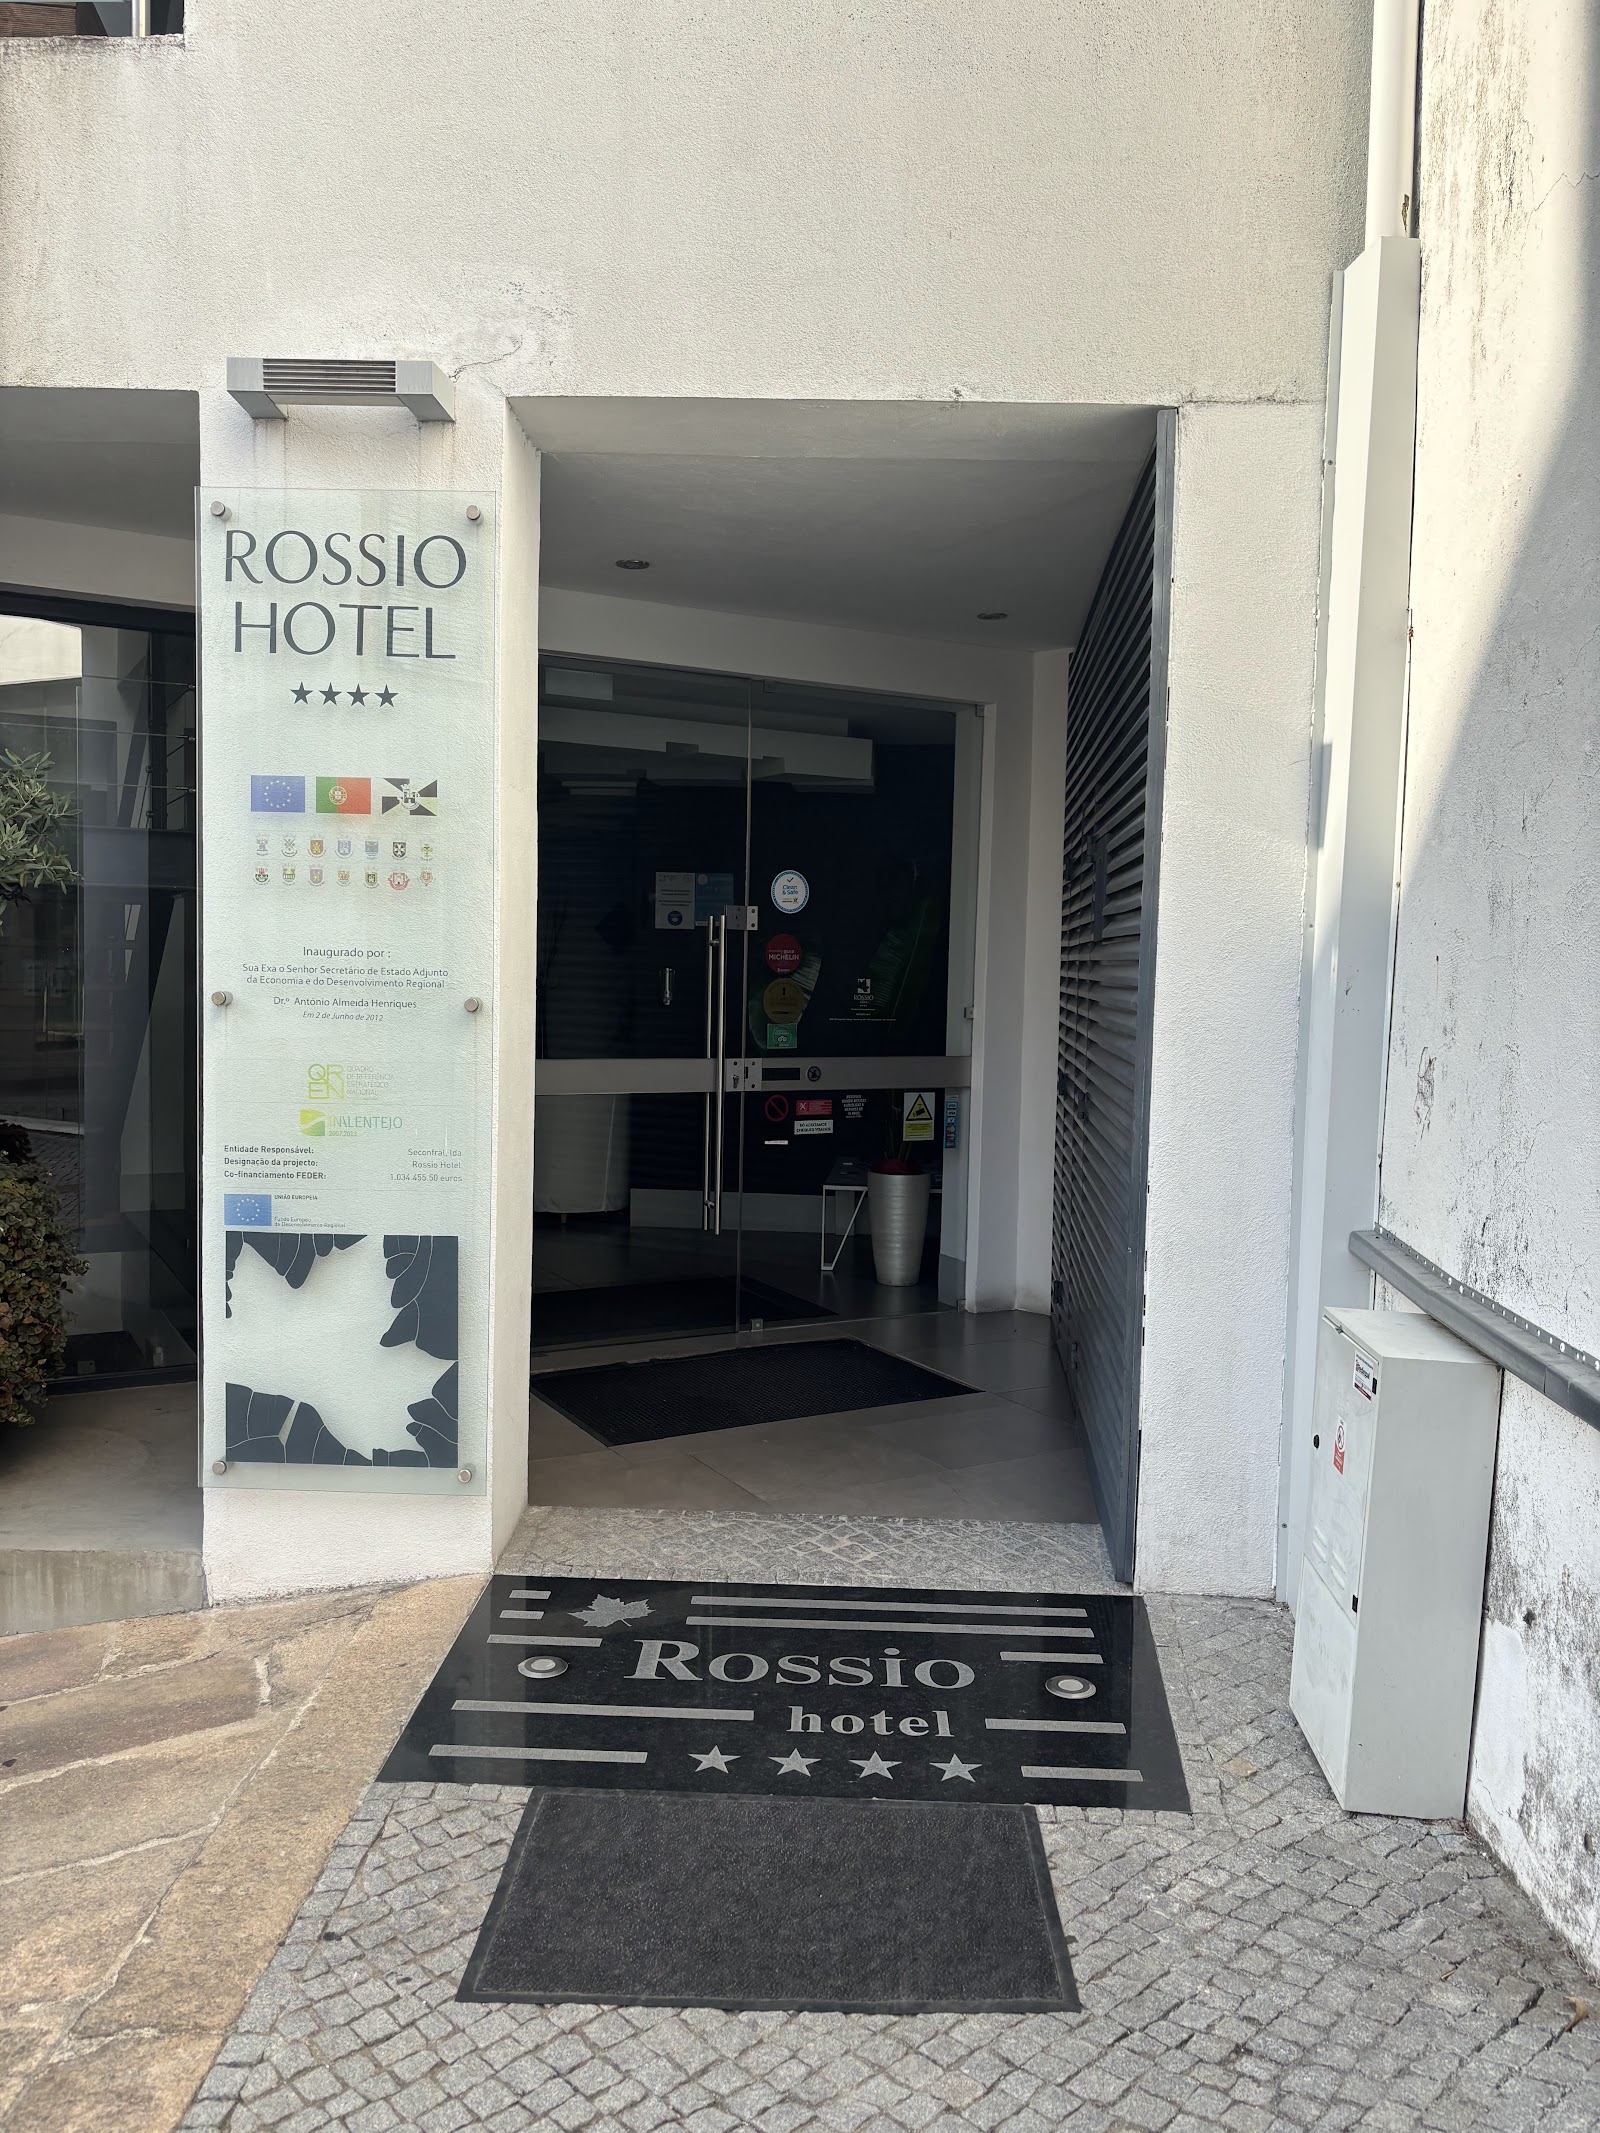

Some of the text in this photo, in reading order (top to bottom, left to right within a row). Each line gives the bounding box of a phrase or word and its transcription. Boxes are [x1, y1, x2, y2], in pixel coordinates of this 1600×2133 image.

[225, 530, 467, 589] ROSSIO
[234, 601, 456, 659] HOTEL
[303, 946, 364, 958] Inaugurado
[366, 950, 384, 959] por
[242, 964, 258, 972] Sua
[261, 964, 276, 972] Exa
[286, 964, 318, 974] Senhor
[320, 966, 365, 975] Secretário
[368, 967, 378, 975] de
[380, 968, 411, 976] Estado
[412, 968, 448, 978] Adjunto
[246, 975, 258, 984] da
[260, 976, 304, 984] Economia
[313, 976, 324, 986] do
[326, 978, 404, 988] Desenvolvimento
[406, 980, 445, 990] Regional
[294, 998, 330, 1006] António
[332, 998, 368, 1007] Almeida
[372, 1000, 417, 1010] Henriques
[260, 1146, 314, 1154] Responsável:
[224, 1158, 269, 1166] Designação
[283, 1160, 318, 1168] projecto:
[412, 1160, 438, 1168] Rossio
[224, 1170, 294, 1178] Co-financiamento
[624, 1640, 975, 1689] Rossio
[786, 1706, 954, 1738] hotel
